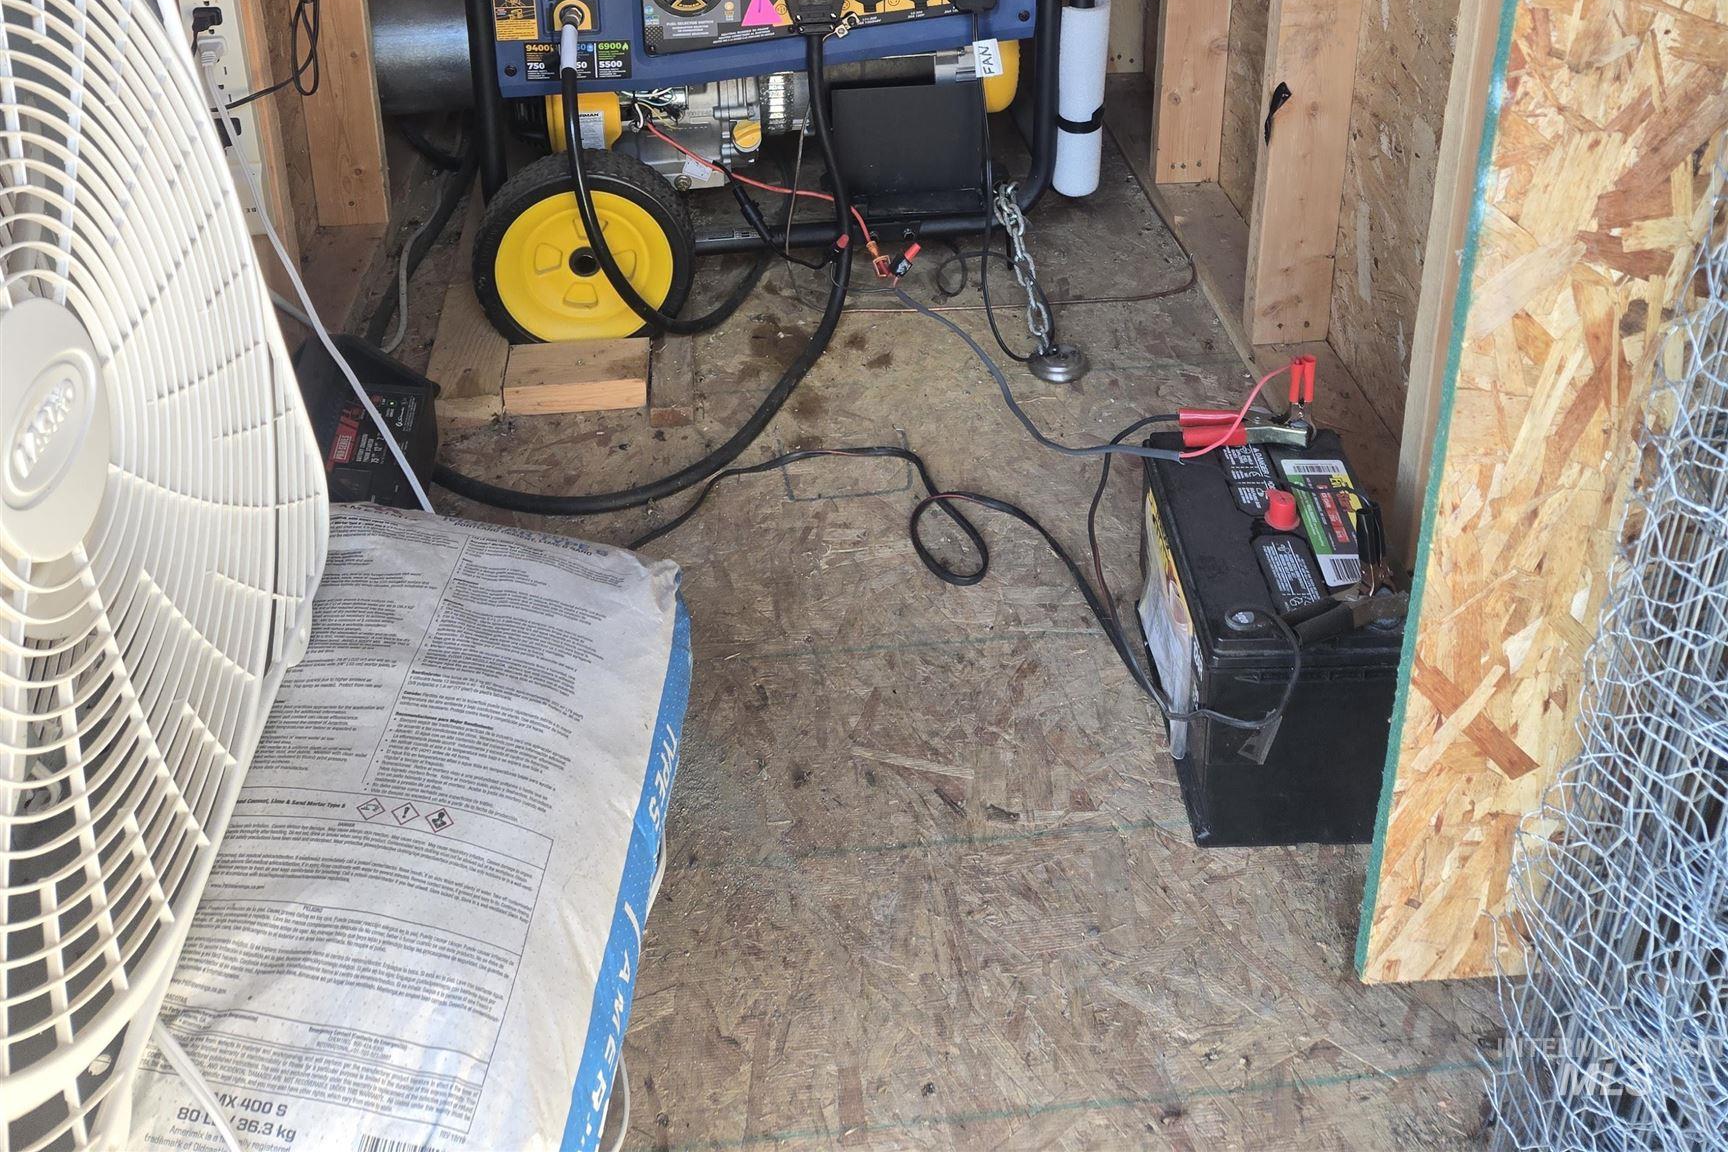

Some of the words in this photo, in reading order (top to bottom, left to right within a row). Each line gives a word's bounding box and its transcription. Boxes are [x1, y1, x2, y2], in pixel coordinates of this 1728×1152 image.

[525, 44, 550, 52] 9400
[598, 42, 621, 50] 6900
[599, 60, 623, 68] 5500
[978, 45, 995, 75] FAN
[655, 724, 678, 799] TYPE
[240, 1097, 273, 1115] 400
[277, 1104, 288, 1117] S
[176, 1106, 200, 1121] 80
[236, 1118, 273, 1135] 36.3
[276, 1123, 297, 1143] kg
